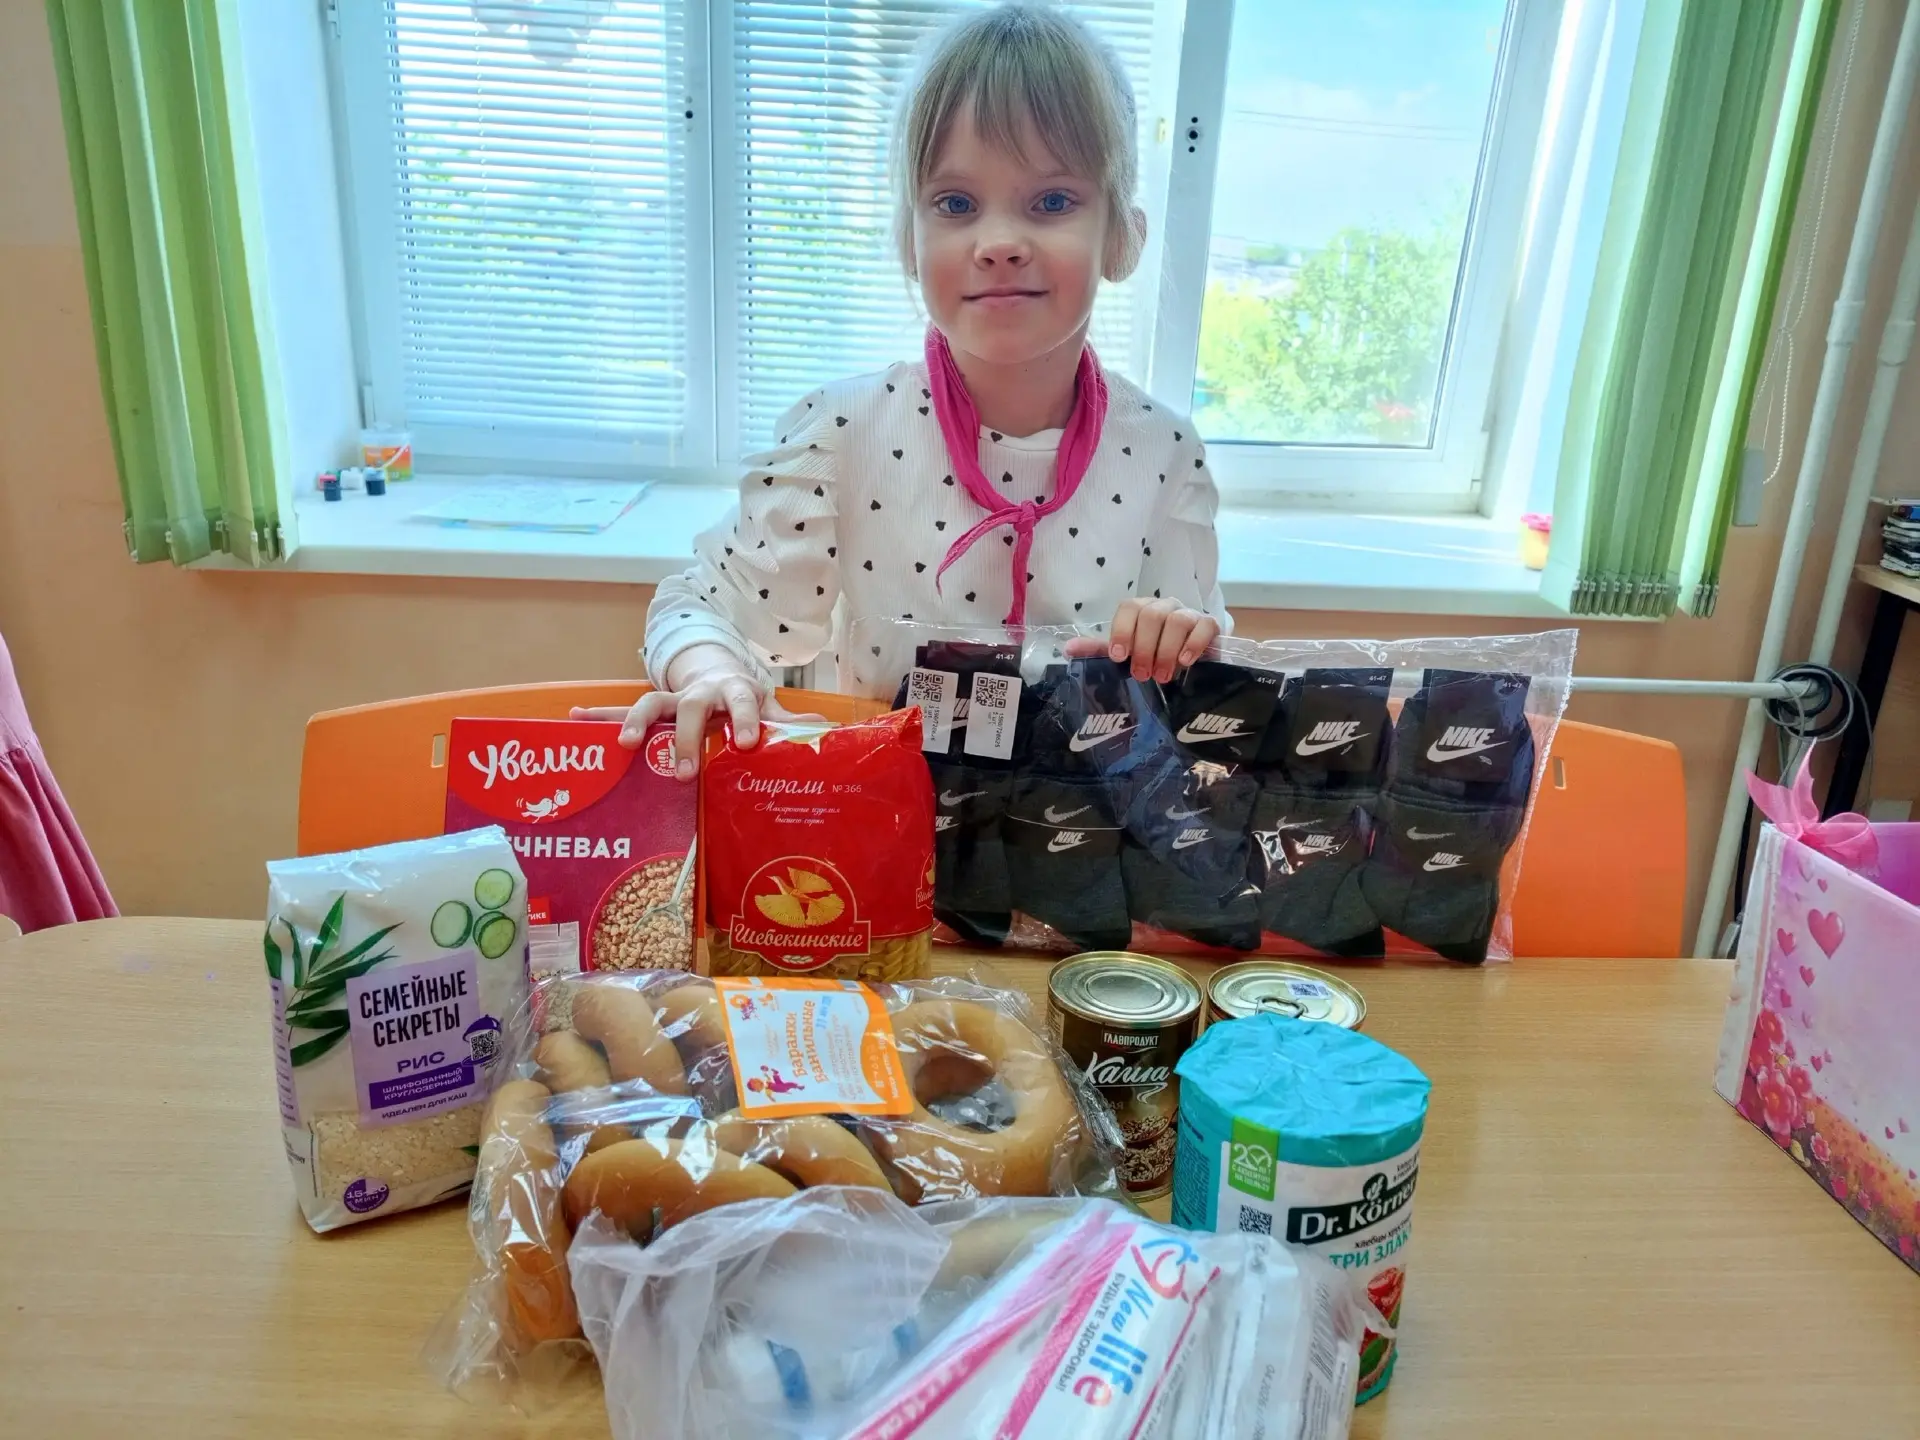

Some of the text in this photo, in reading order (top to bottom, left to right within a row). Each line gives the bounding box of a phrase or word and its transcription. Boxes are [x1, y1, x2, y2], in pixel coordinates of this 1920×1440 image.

[1079, 712, 1130, 735] NIKE
[1191, 713, 1245, 734] NIKE
[1310, 721, 1361, 742] NIKE
[1438, 726, 1495, 748] NIKE
[468, 739, 606, 790] Увелка
[737, 771, 825, 796] Спирали
[935, 815, 954, 829] IKE
[1055, 831, 1086, 844] NIKE
[1182, 828, 1210, 841] NIKE
[1304, 835, 1335, 848] NIKE
[507, 836, 631, 859] ЧНЕВАЯ
[1432, 852, 1464, 866] NIKE
[734, 923, 863, 948] Шебекинские
[359, 970, 468, 1019] СЕМЕЙНЫЕ
[373, 1003, 461, 1048] СЕКРЕТЫ
[1103, 1032, 1159, 1046] ГЛАВПРОДУКТ
[396, 1051, 446, 1073] РИС
[1085, 1051, 1170, 1085] Каша
[382, 1067, 463, 1094] ШЛИФОВАННЫЙ
[384, 1075, 462, 1101] КРУГЛОЗЕРНЫЙ
[381, 1092, 468, 1119] ИДЕАЛЕН ДЛЯ КАШ
[1299, 1212, 1343, 1240] Dr.
[1328, 1249, 1370, 1269] ТРИ
[1100, 1272, 1126, 1321] БУДЬТЕ
[1073, 1278, 1154, 1407] New life
